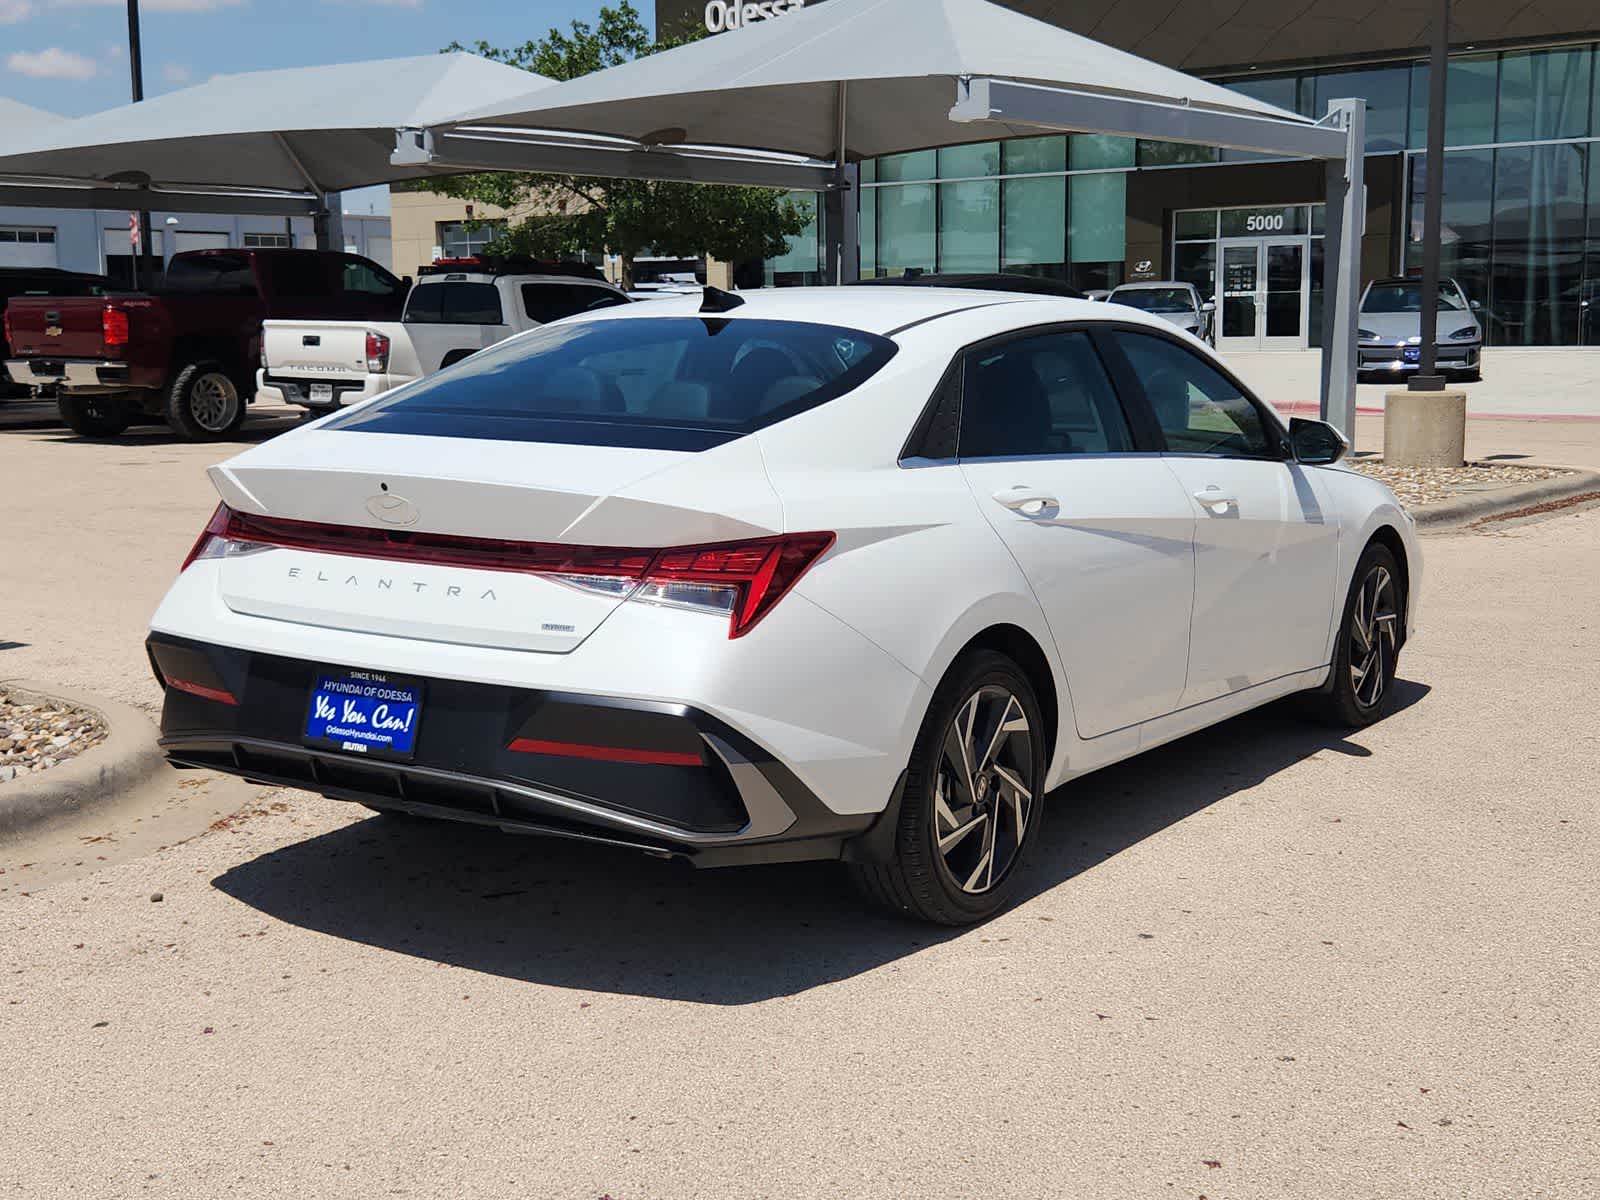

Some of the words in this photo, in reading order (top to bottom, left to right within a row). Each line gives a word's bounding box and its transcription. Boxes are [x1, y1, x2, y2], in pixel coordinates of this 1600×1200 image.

[1246, 215, 1283, 231] 5000
[288, 567, 497, 601] ELANTRA
[350, 671, 370, 681] SINCE
[323, 680, 362, 695] HYUNDAI
[363, 686, 377, 697] OF
[377, 689, 413, 703] ODESSA
[314, 695, 336, 721] Yes
[341, 699, 367, 724] You
[371, 704, 415, 733] Can!
[325, 724, 393, 744] OdessaHyundai.com
